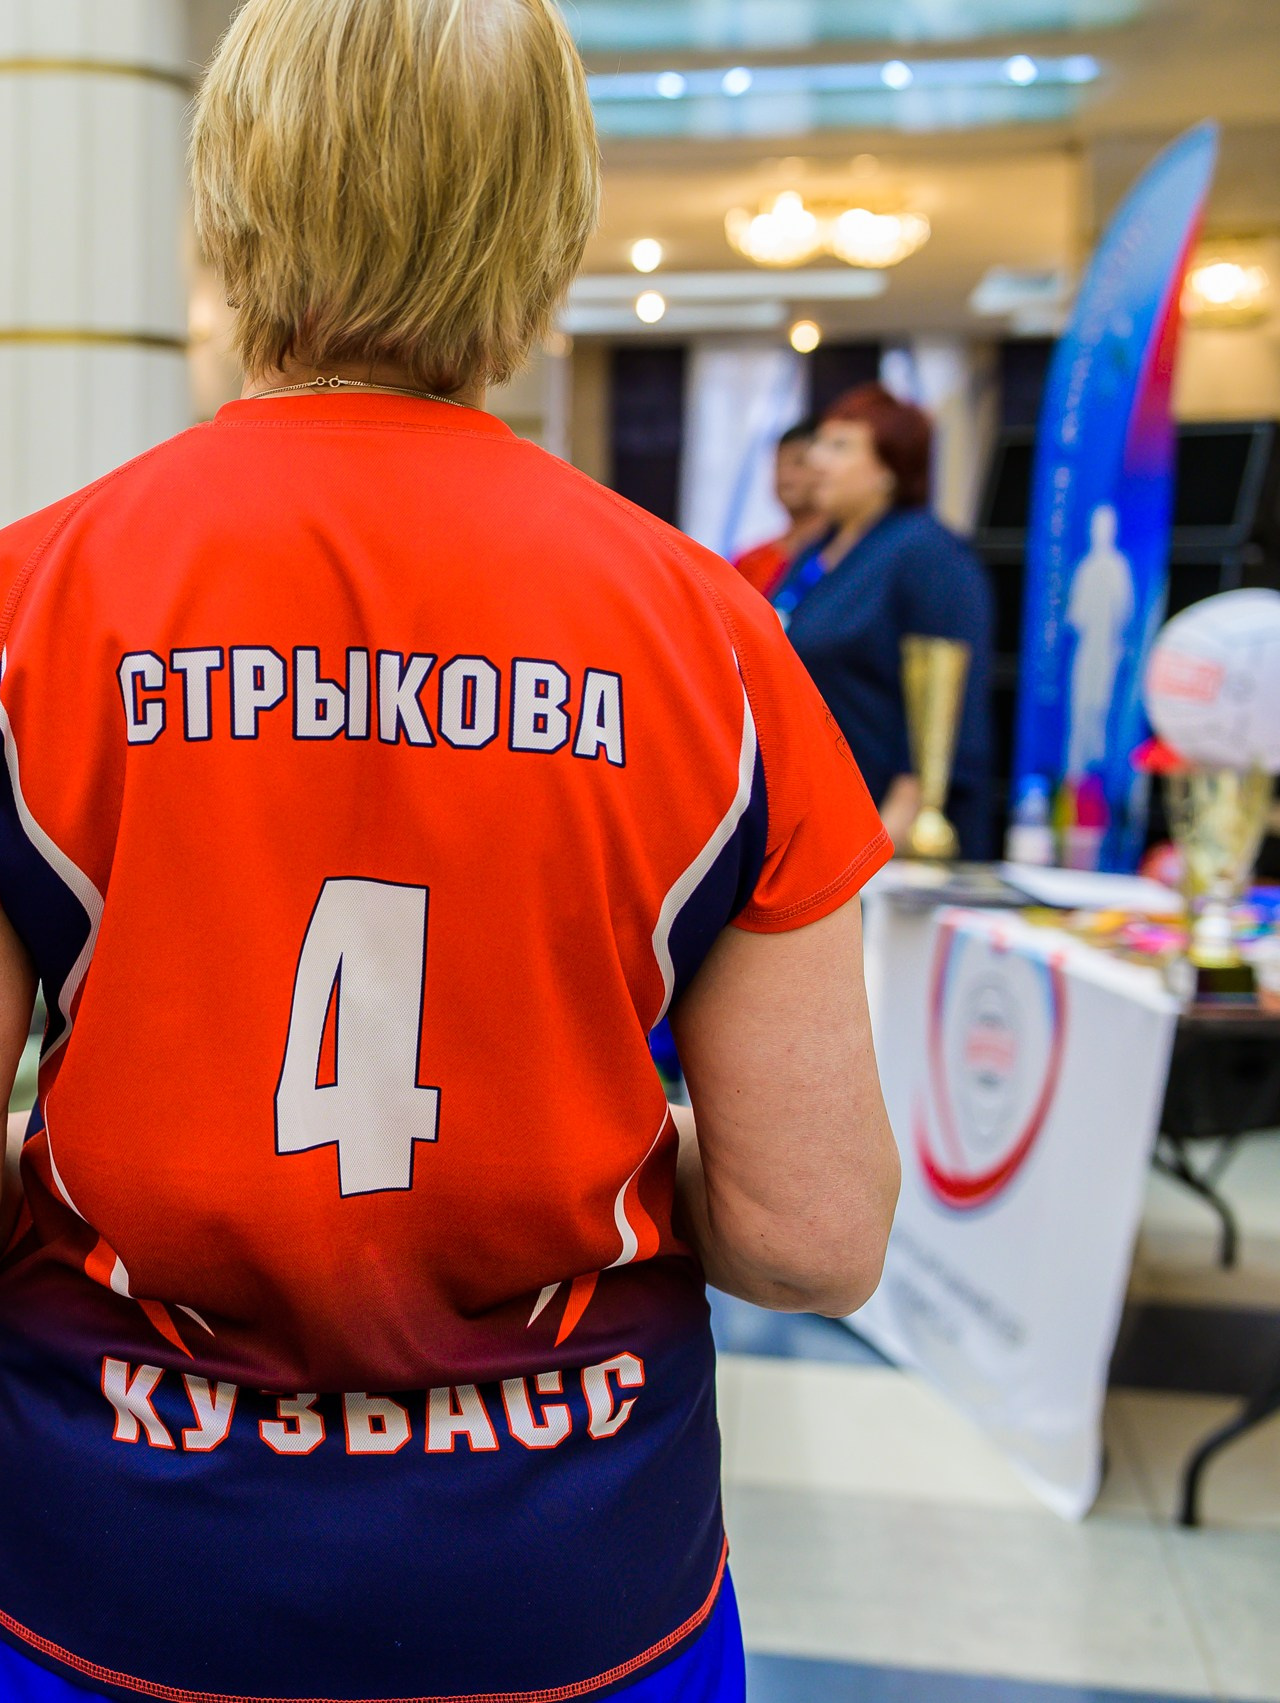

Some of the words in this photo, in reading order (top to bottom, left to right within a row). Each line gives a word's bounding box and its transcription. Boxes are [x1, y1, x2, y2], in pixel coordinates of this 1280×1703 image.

[119, 646, 626, 768] СТРЫКОВА
[274, 876, 441, 1199] 4
[101, 1352, 645, 1455] КУЗБАСС
